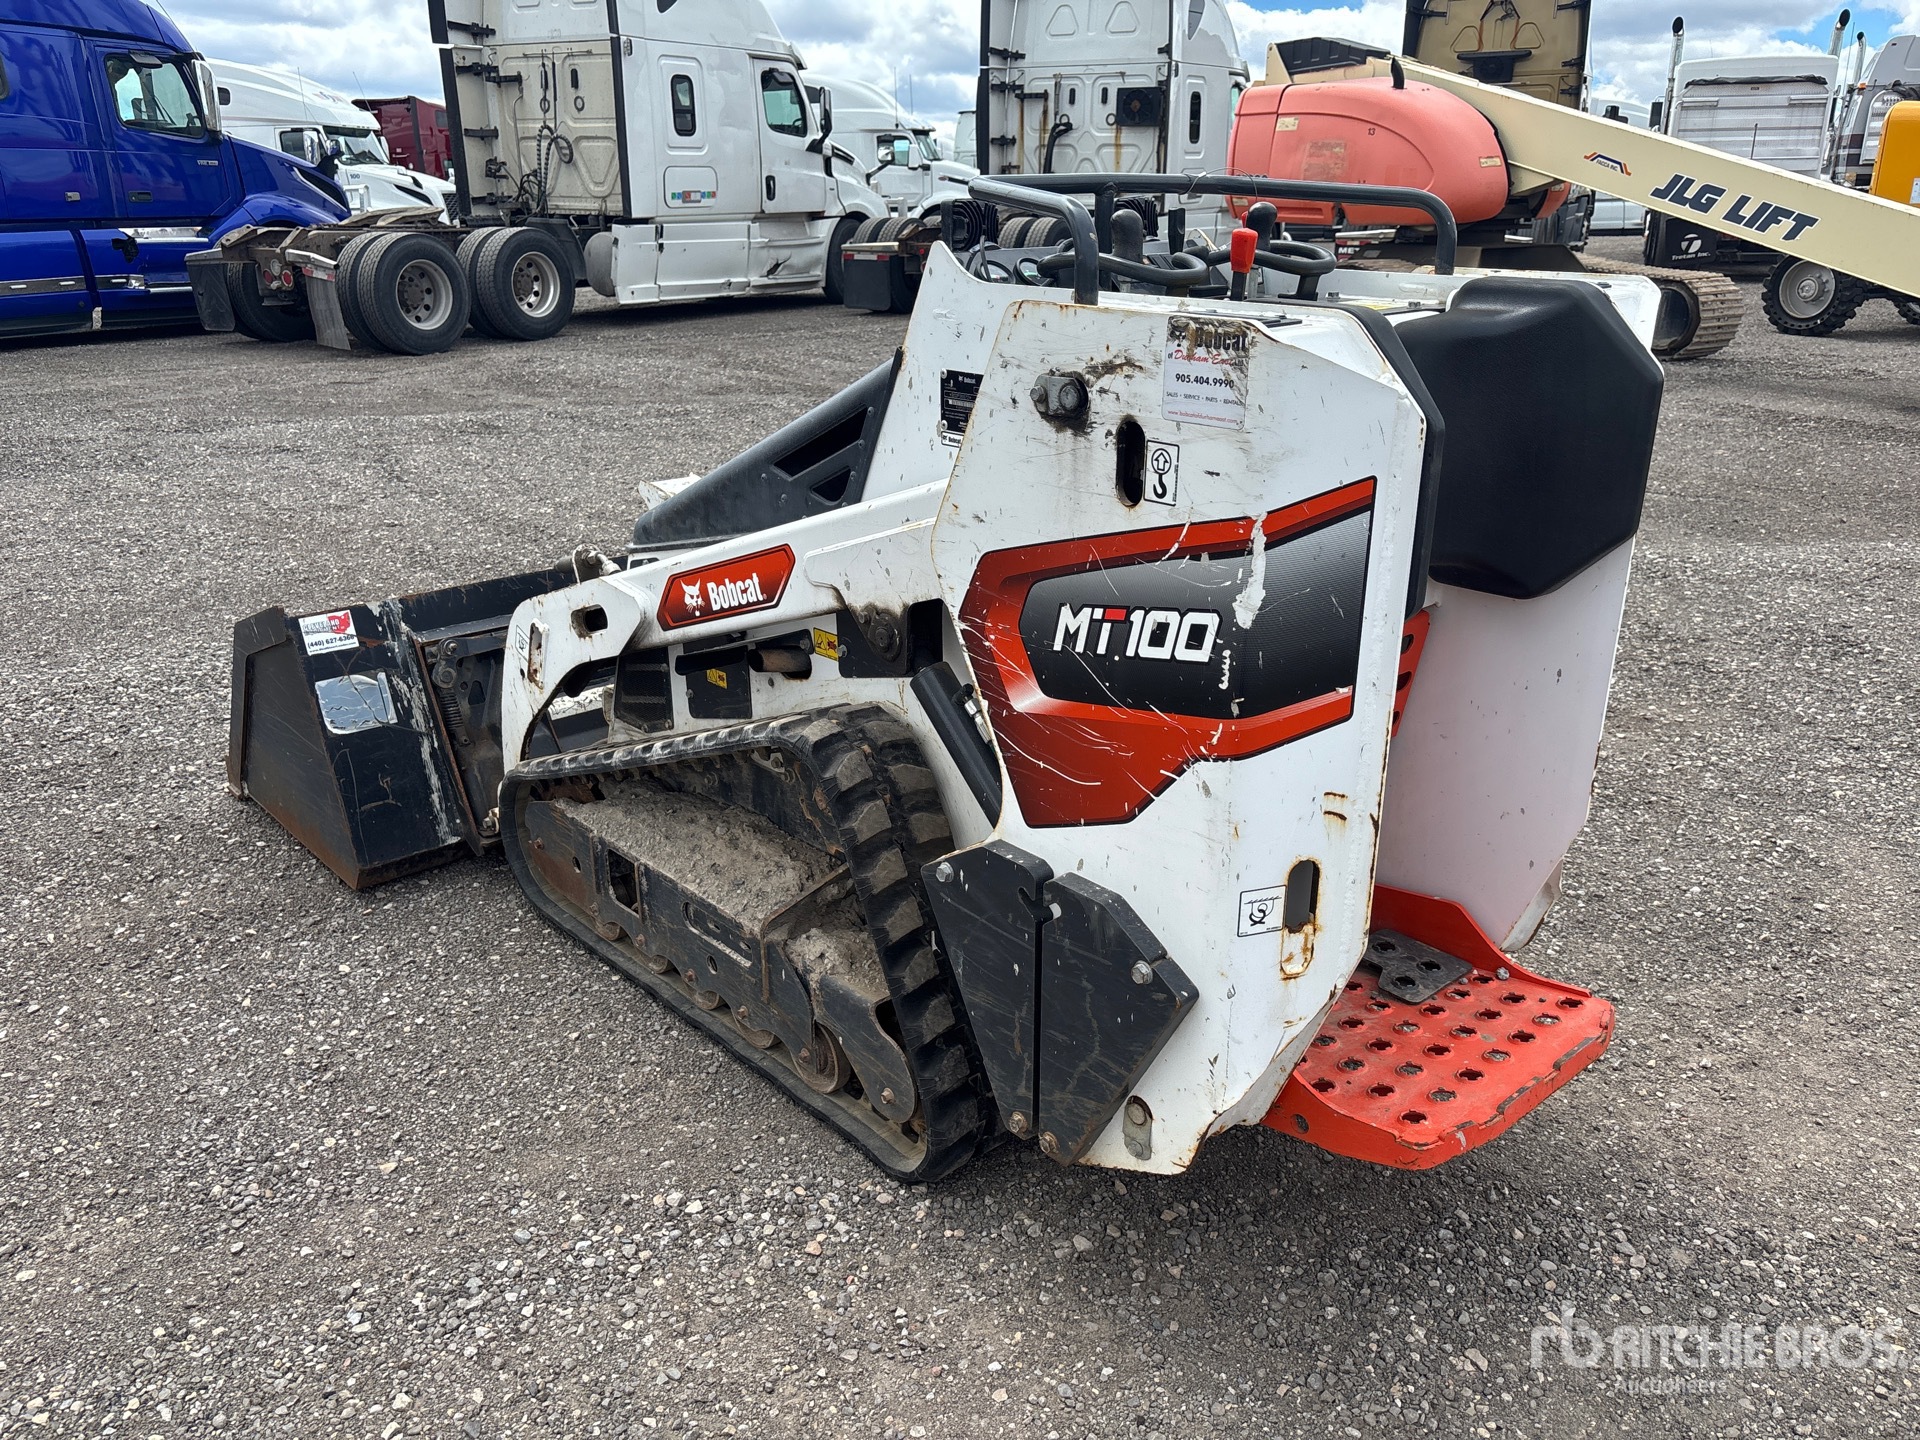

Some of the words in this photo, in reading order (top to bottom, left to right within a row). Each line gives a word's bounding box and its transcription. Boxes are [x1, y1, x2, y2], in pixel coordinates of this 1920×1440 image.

[1649, 173, 1728, 214] JLG
[1721, 194, 1821, 241] LIFT
[1175, 373, 1235, 389] 905.404.9990
[1183, 393, 1201, 401] SERVICE
[706, 572, 764, 612] Bobcat
[308, 640, 324, 649] (440)
[1052, 602, 1221, 664] MT100
